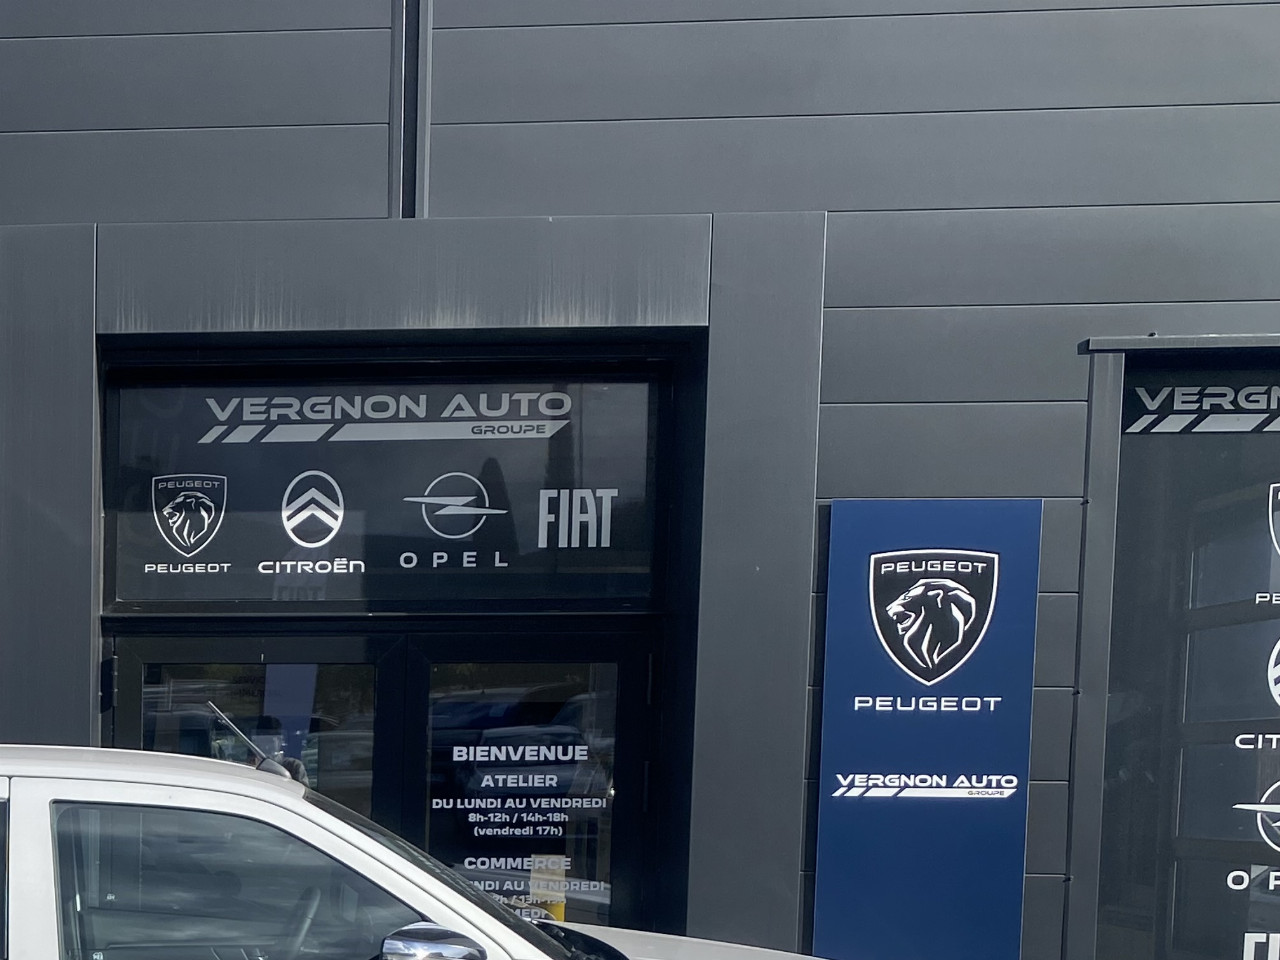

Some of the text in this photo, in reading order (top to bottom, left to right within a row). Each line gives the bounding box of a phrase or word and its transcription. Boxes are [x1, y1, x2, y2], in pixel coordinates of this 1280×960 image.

[205, 392, 572, 420] VERGNON AUTO
[471, 424, 547, 436] GROUPE
[158, 480, 221, 490] PEUGEOT
[537, 488, 619, 548] FIAT
[399, 551, 509, 568] OPEL
[144, 563, 232, 573] PEUGEOT
[881, 560, 988, 575] PEUGEOT
[854, 696, 1002, 711] PEUGEOT
[452, 745, 589, 762] BIENVENUE
[480, 774, 558, 788] ATELIER
[835, 773, 1019, 788] VERGNON AUTO
[432, 798, 607, 809] DU LUNDI AU VENDREDI
[468, 812, 510, 822] 8h-12h
[520, 812, 569, 823] 14h-18h
[473, 826, 563, 837] (vendredi 17h)
[464, 857, 572, 870] COMMERCE
[471, 881, 605, 892] NDI AU VENDREDI
